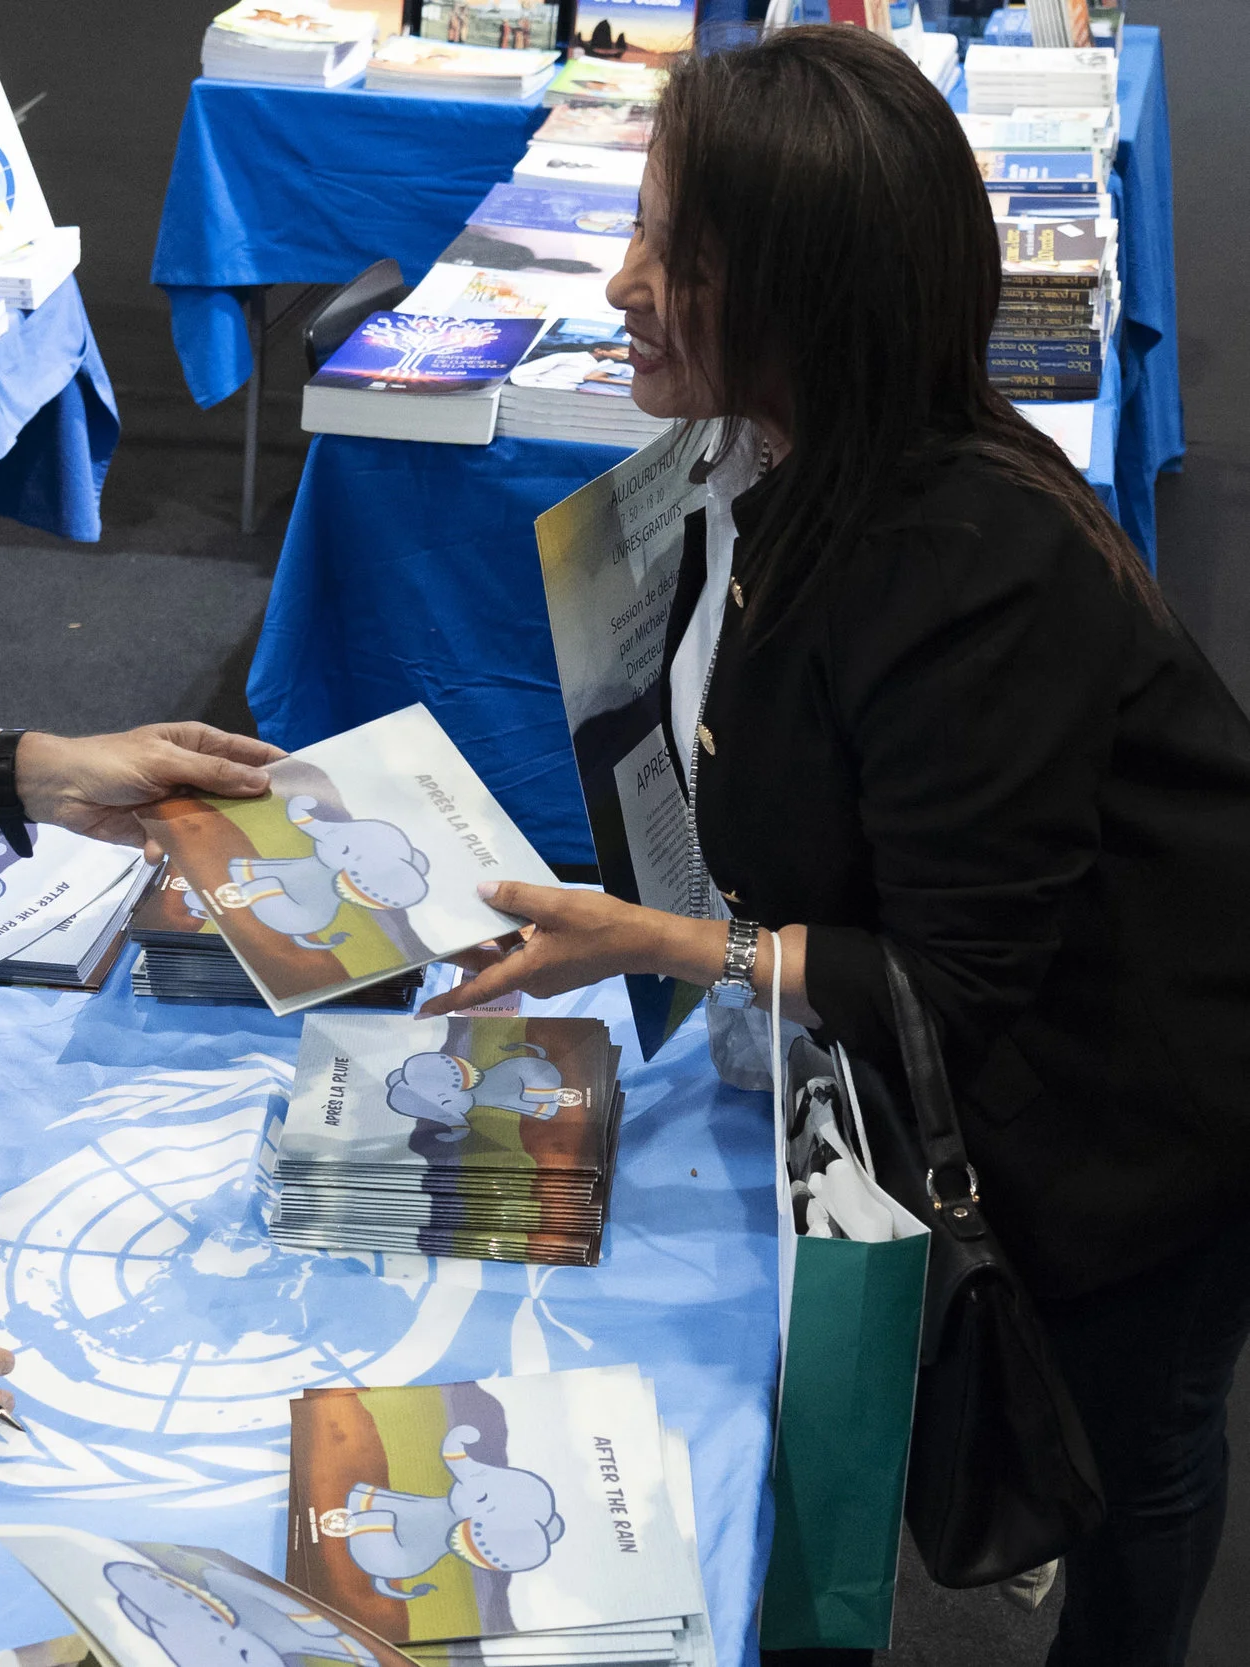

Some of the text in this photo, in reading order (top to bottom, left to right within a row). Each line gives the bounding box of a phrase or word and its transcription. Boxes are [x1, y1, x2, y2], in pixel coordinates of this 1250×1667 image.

[1065, 343, 1090, 355] Rice
[1067, 360, 1091, 372] Rice
[611, 501, 682, 566] LIVRES GRATUITS
[611, 600, 644, 635] Session
[645, 588, 656, 607] de
[658, 569, 680, 598] dédic
[619, 608, 669, 661] par Michael
[625, 638, 666, 680] Directeur
[414, 774, 499, 868] APRÈS LA PLUIE
[15, 907, 40, 921] THE
[36, 881, 70, 907] AFTER
[321, 1056, 349, 1127] APRÈS LA PLUIE
[593, 1436, 638, 1553] AFTER THE RAIN
